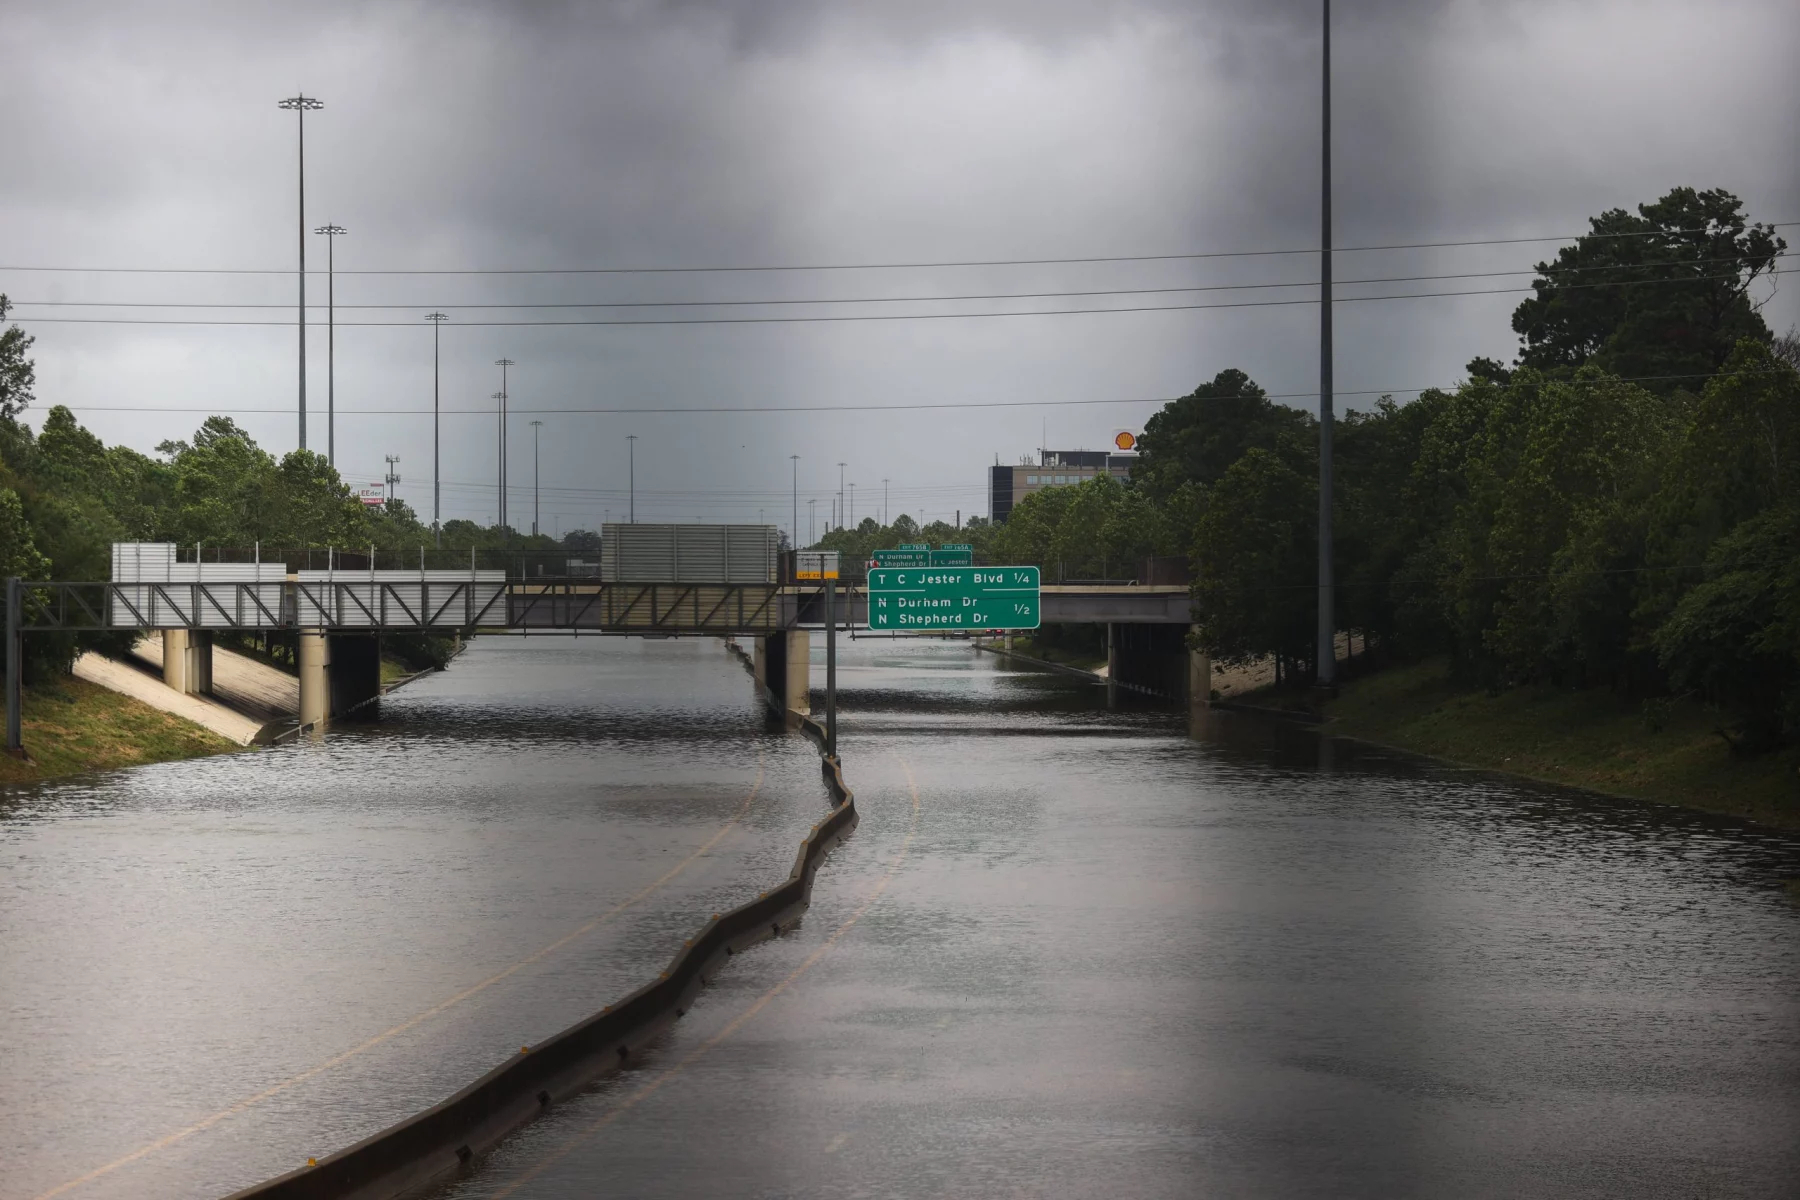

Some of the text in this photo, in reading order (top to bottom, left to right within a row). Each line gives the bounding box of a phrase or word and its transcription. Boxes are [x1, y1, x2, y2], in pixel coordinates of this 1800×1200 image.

[878, 572, 1030, 584] T C Jester Blvd 1/4
[878, 597, 978, 608] N Durham Dr
[1014, 604, 1030, 615] 1/2
[878, 613, 988, 626] N Shepherd Dr
